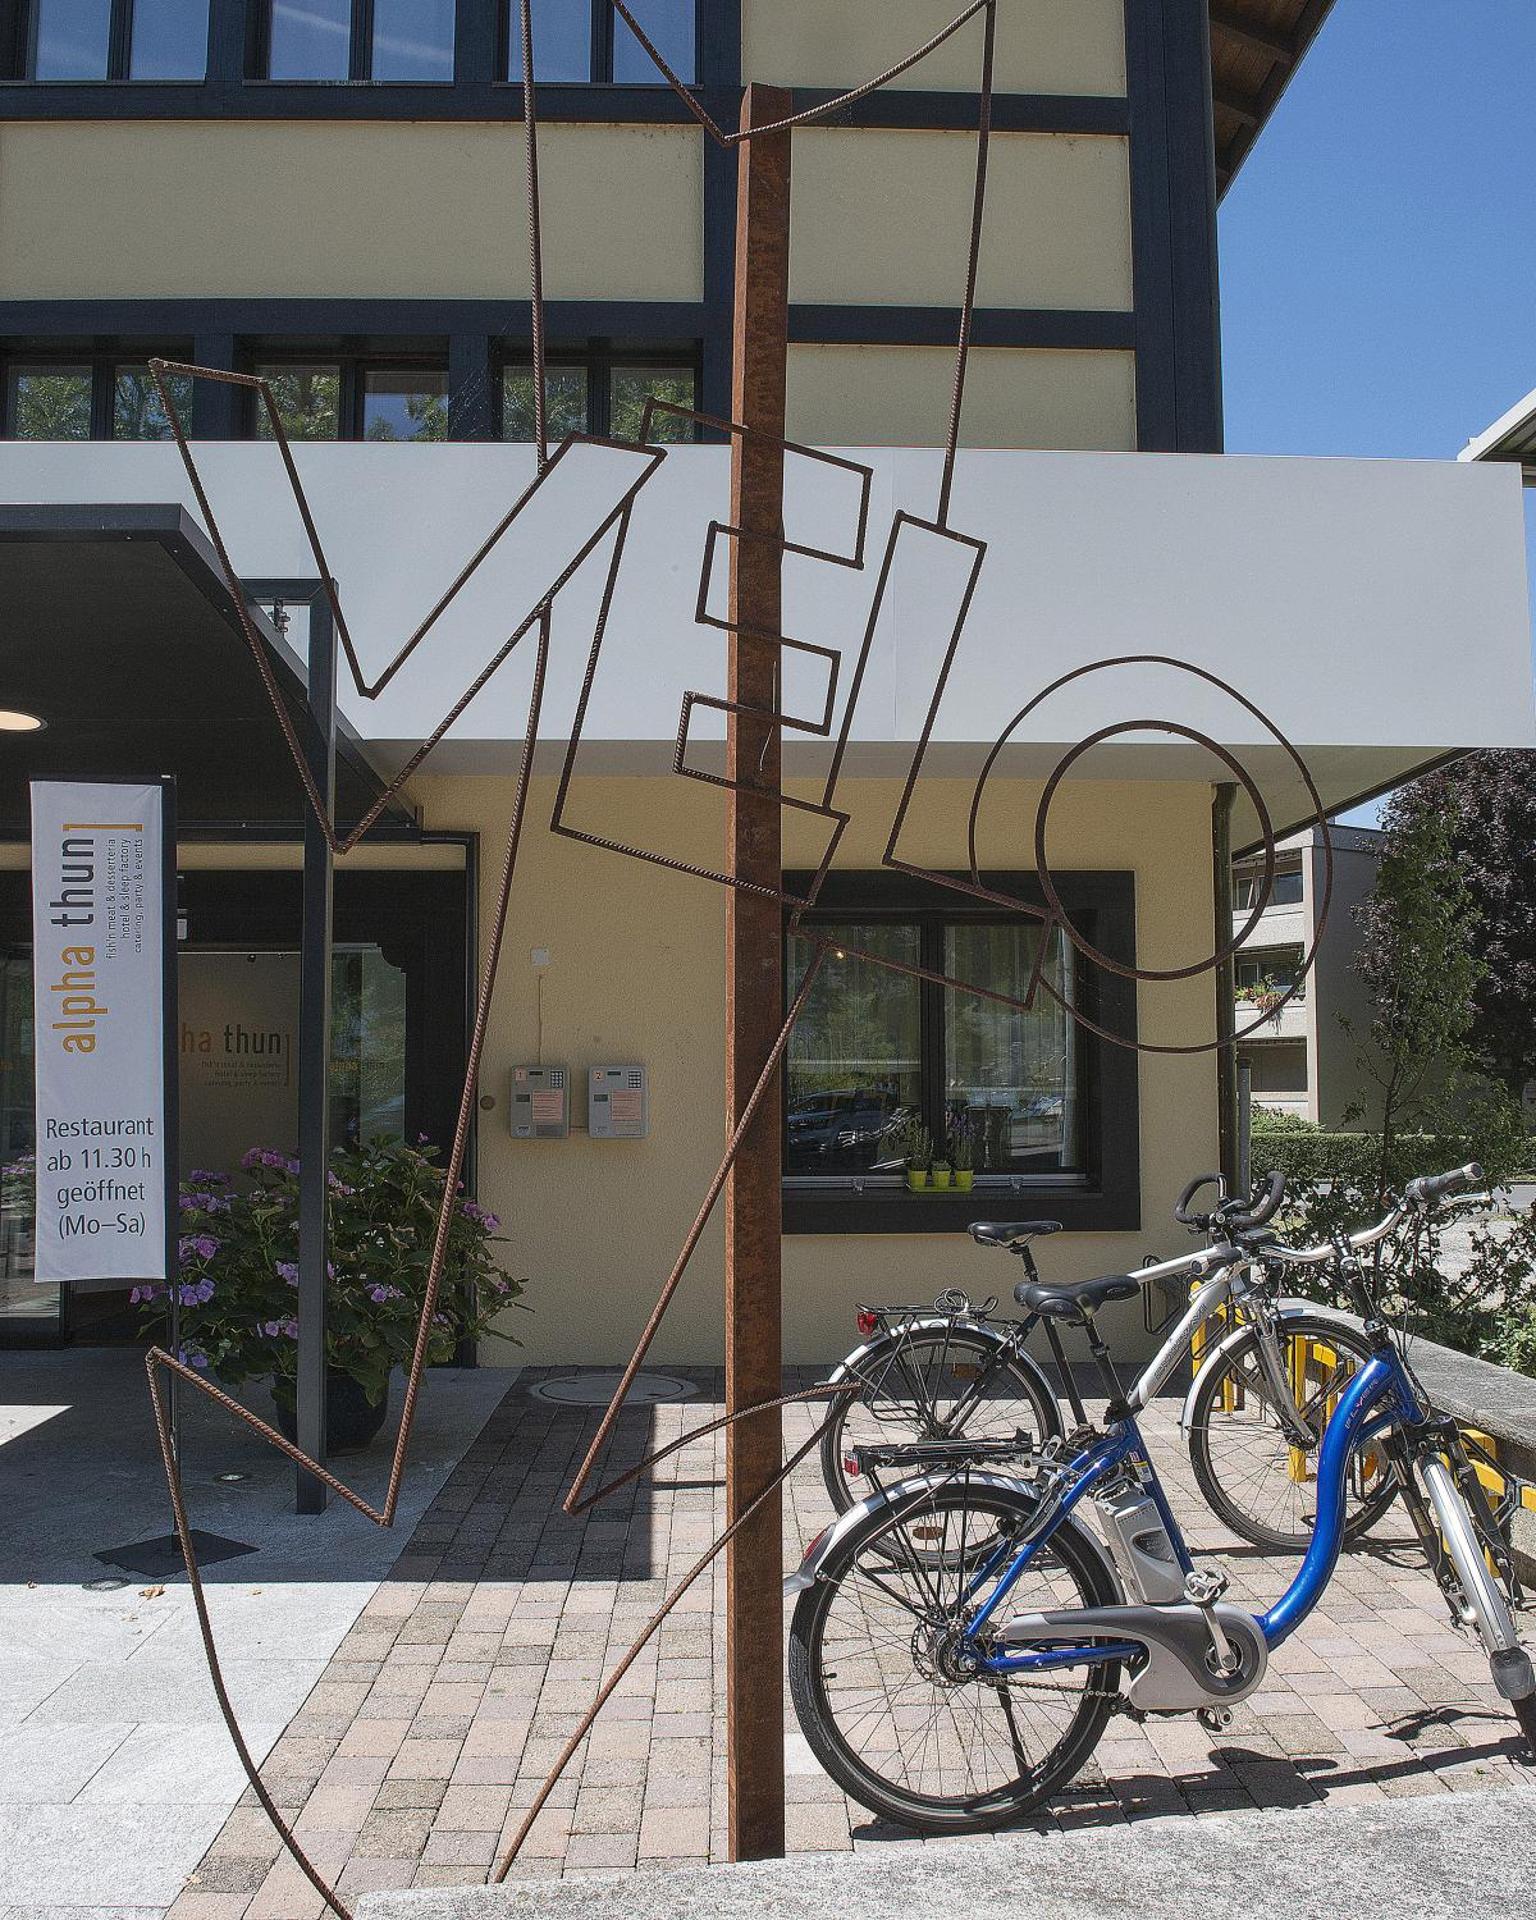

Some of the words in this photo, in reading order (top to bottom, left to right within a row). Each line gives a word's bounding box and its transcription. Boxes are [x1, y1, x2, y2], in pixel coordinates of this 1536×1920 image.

[106, 839, 116, 892] desserteria
[119, 839, 131, 872] factory
[135, 839, 143, 870] events
[119, 875, 132, 900] sleep
[135, 884, 144, 908] party
[107, 906, 116, 930] meat
[120, 914, 130, 939] hotel
[50, 946, 108, 1054] alpha
[46, 1117, 154, 1139] Restaurant
[47, 1149, 72, 1172] ab
[81, 1147, 136, 1169] 11.30
[142, 1146, 151, 1168] h
[57, 1179, 145, 1209] geöffnet
